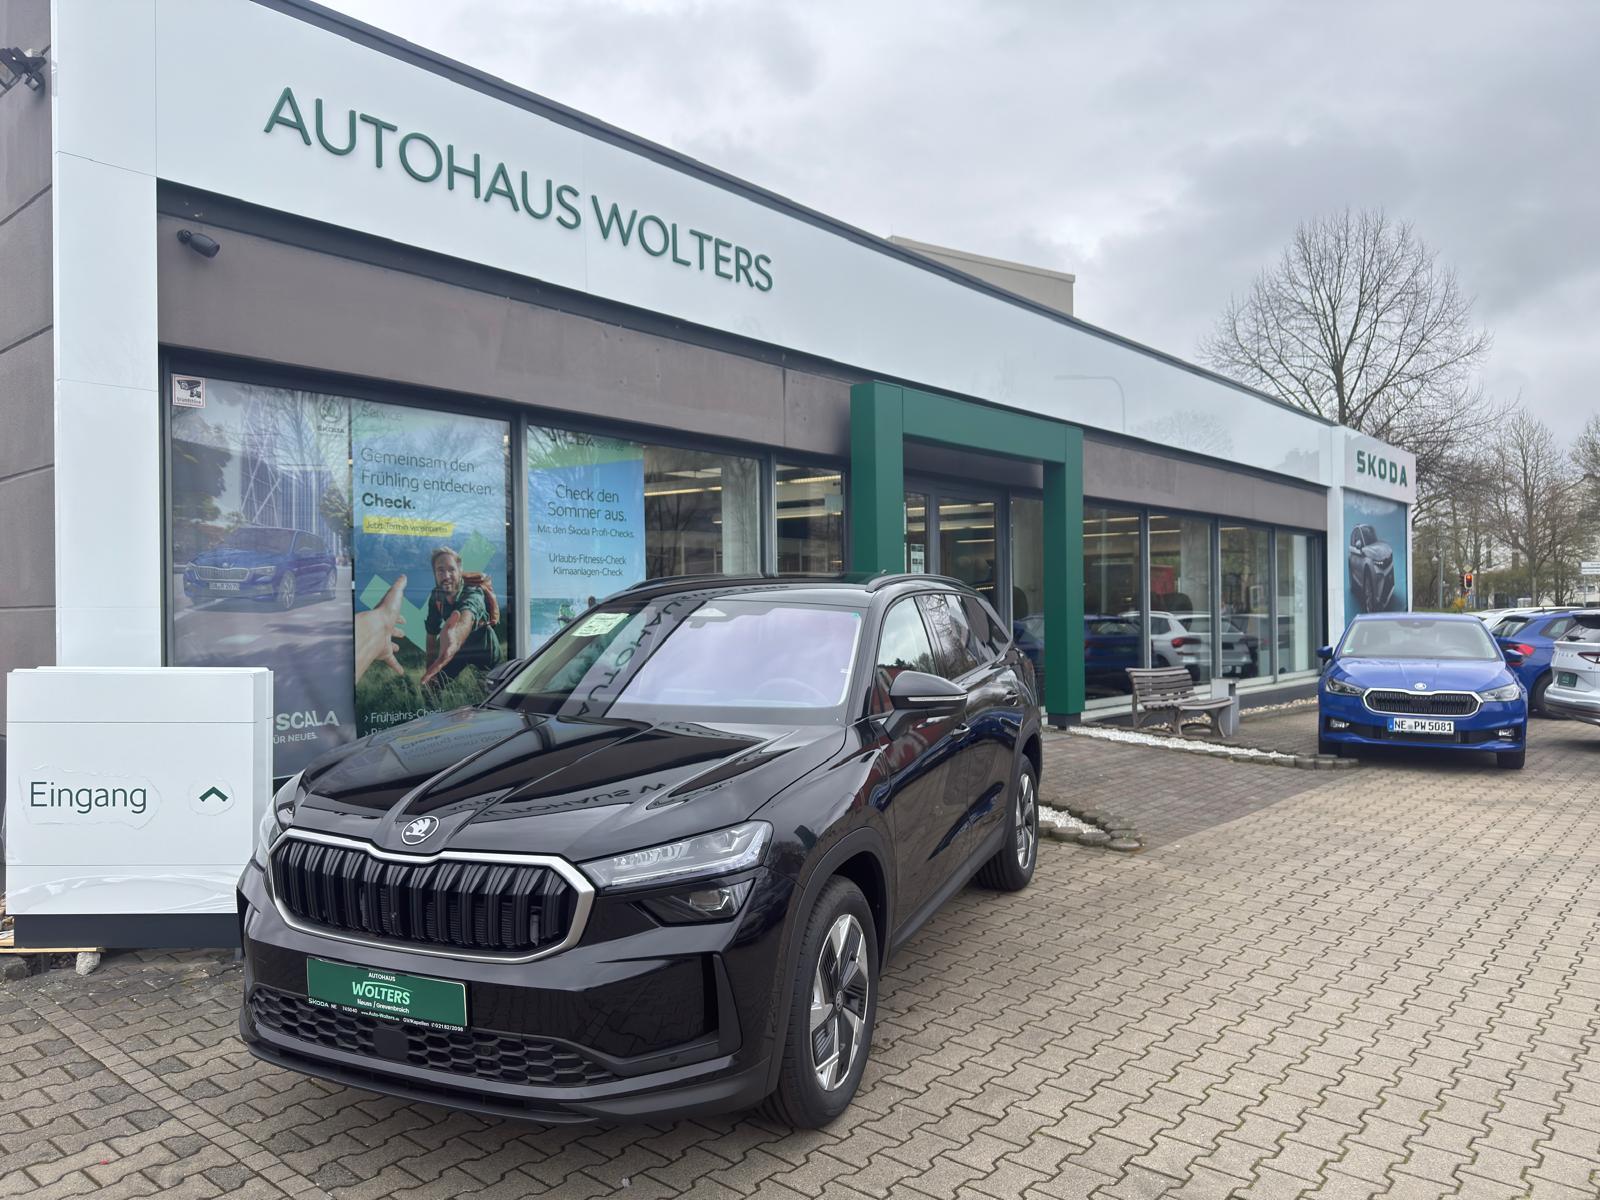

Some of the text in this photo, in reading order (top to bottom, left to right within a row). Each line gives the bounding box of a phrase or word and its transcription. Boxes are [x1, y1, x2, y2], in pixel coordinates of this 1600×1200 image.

[264, 87, 774, 292] AUTOHAUS WOLTERS
[360, 447, 475, 473] Gemeinsam den
[361, 470, 495, 497] Frühling entdecken.
[362, 492, 416, 510] Check.
[555, 484, 619, 503] Check den
[547, 502, 627, 522] Sommer aus.
[537, 524, 551, 534] Mit
[552, 525, 567, 535] den
[549, 553, 626, 565] Urlaubs-Fitness-Check
[553, 567, 624, 578] Klimaanlagen-Check
[276, 710, 340, 731] SCALA
[1394, 720, 1453, 732] NE PW 5081
[273, 732, 287, 744] ÜR
[30, 781, 147, 815] Eingang
[368, 972, 396, 982] AUTOHAUS
[352, 981, 411, 1005] WOLTERS
